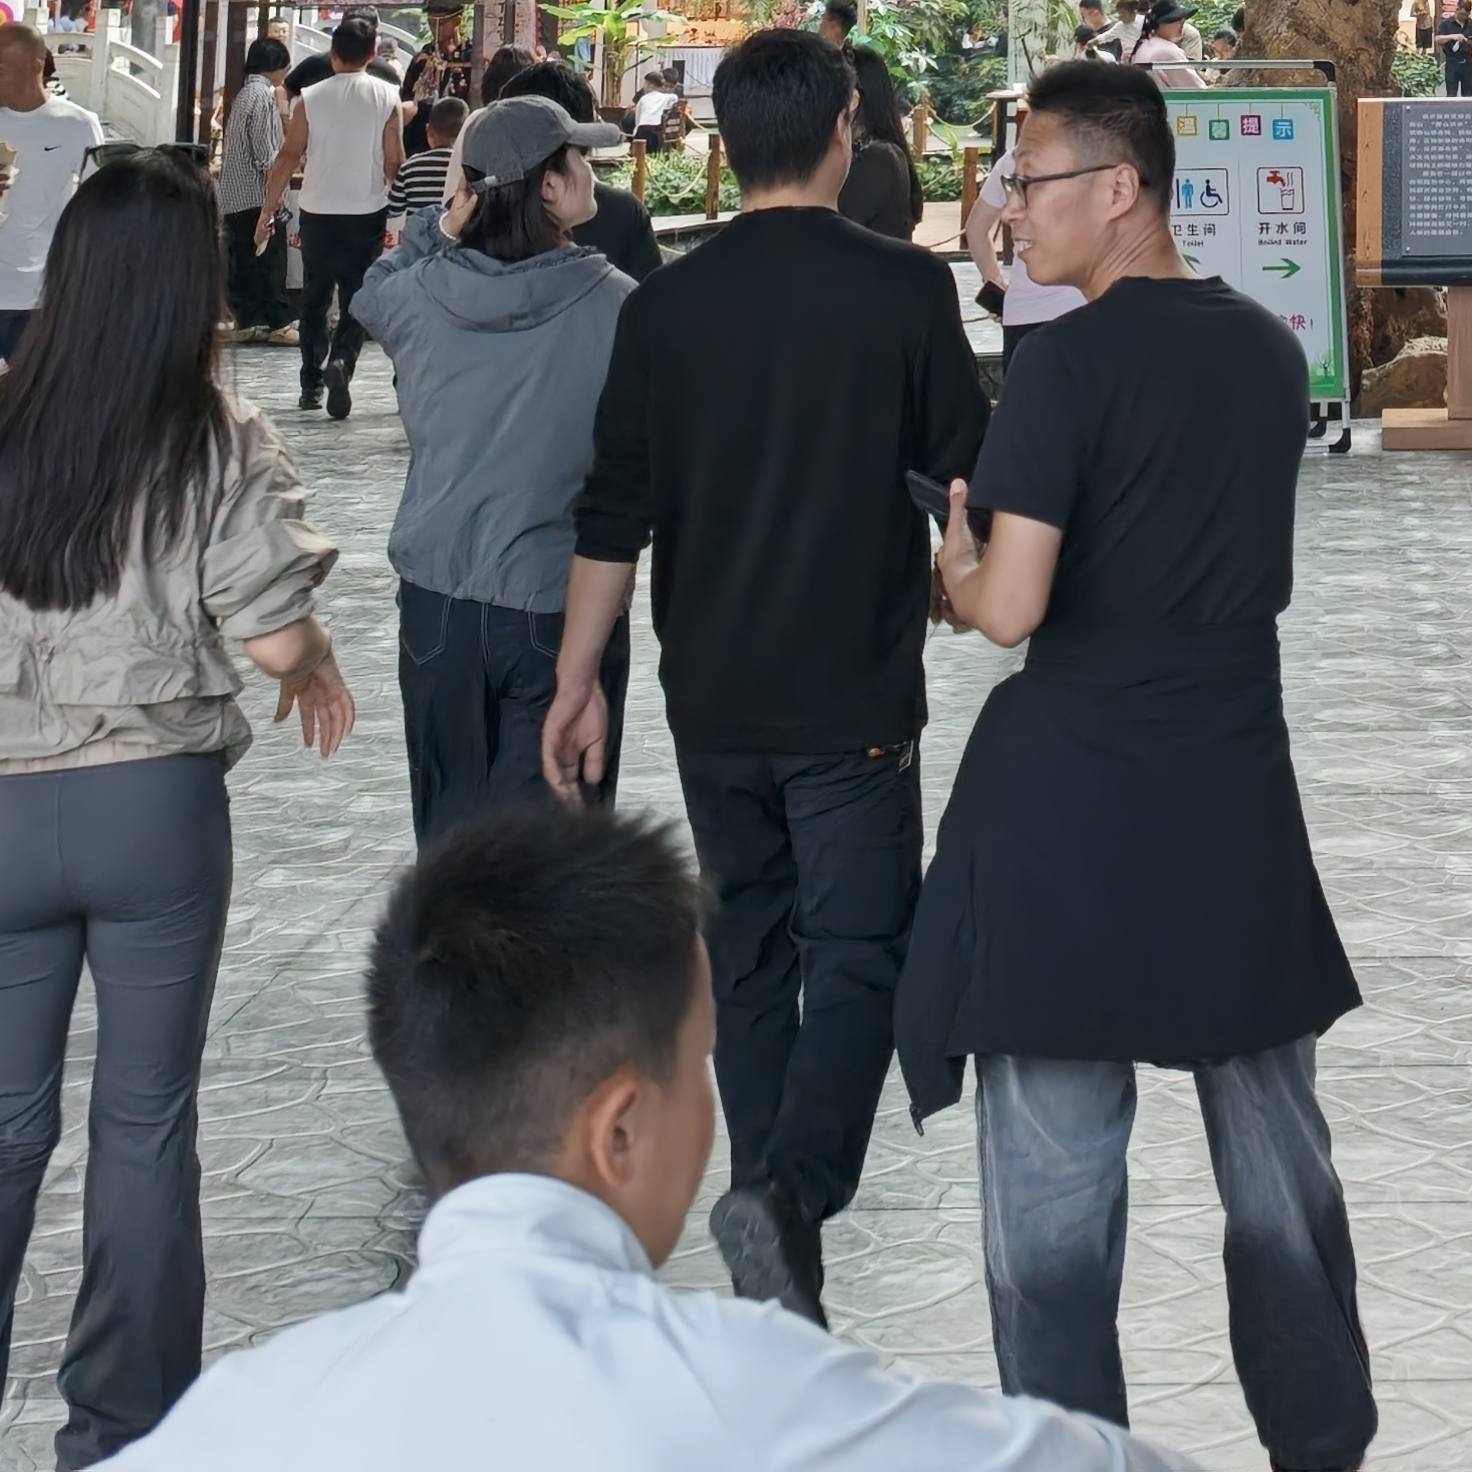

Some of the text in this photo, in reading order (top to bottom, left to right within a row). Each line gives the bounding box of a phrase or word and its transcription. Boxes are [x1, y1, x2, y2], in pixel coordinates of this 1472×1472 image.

[1172, 223, 1217, 237] 卫生间
[1258, 222, 1307, 236] 开水间
